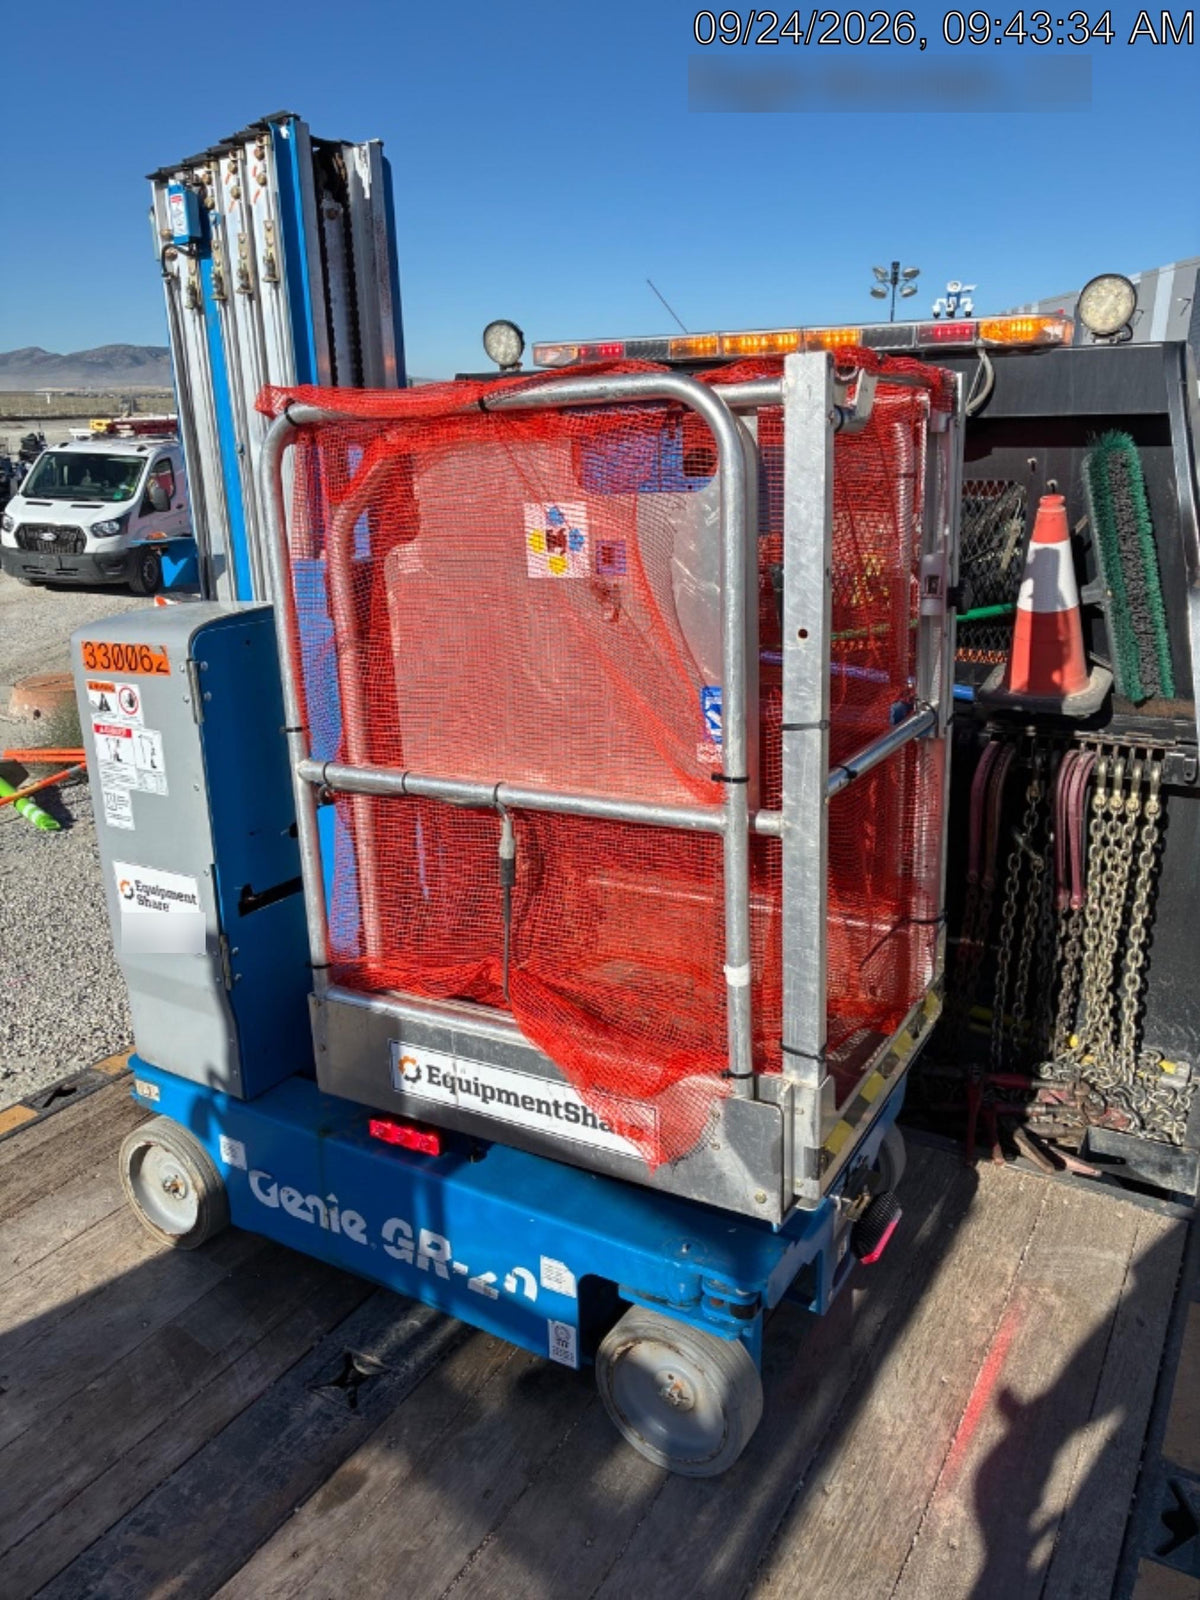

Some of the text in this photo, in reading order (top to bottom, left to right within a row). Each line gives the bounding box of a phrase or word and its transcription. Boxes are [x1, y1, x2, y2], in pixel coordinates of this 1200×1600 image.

[134, 879, 198, 905] Equipment
[136, 894, 170, 912] Share
[248, 1169, 368, 1246] Genie
